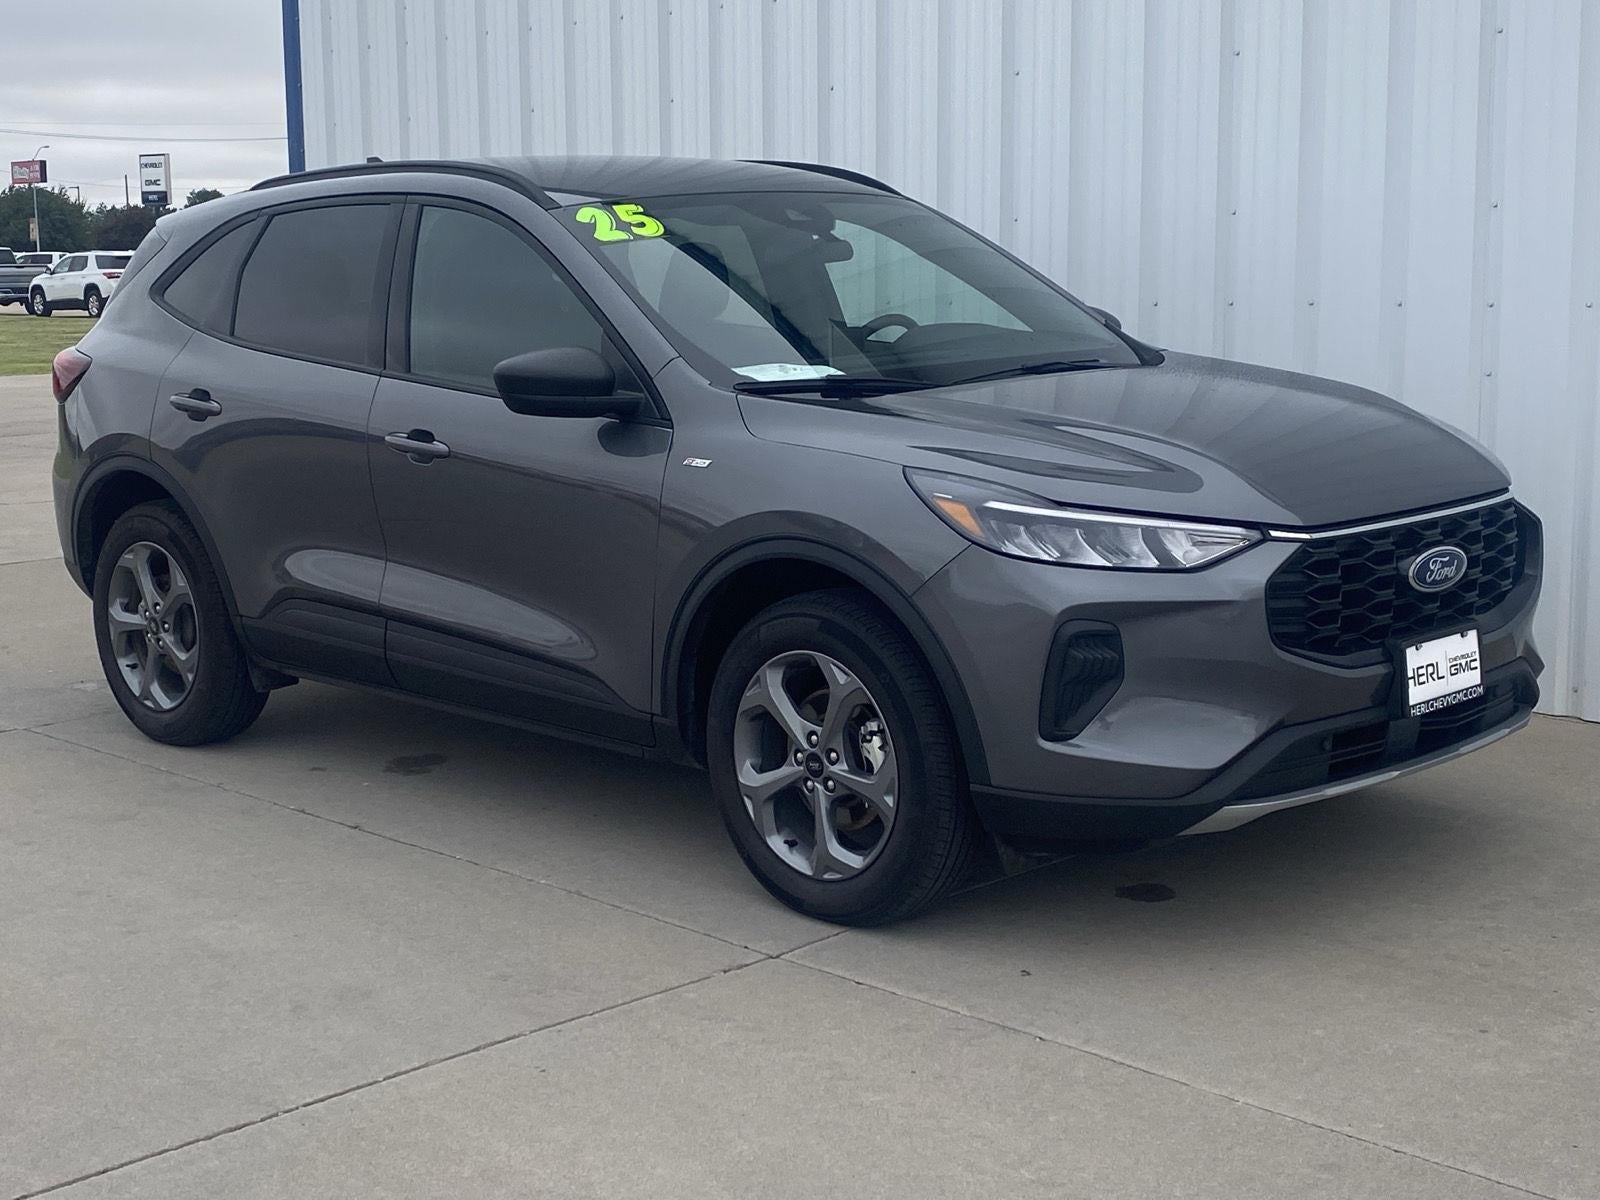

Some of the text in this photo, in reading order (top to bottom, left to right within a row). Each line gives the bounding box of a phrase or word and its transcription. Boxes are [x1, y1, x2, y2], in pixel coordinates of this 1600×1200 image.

[575, 203, 665, 242] 25
[1426, 556, 1457, 583] Ford
[1449, 650, 1476, 663] CHEVROLET
[1450, 658, 1478, 676] GMC
[1410, 685, 1484, 717] HERLCHEVYGMC.COM
